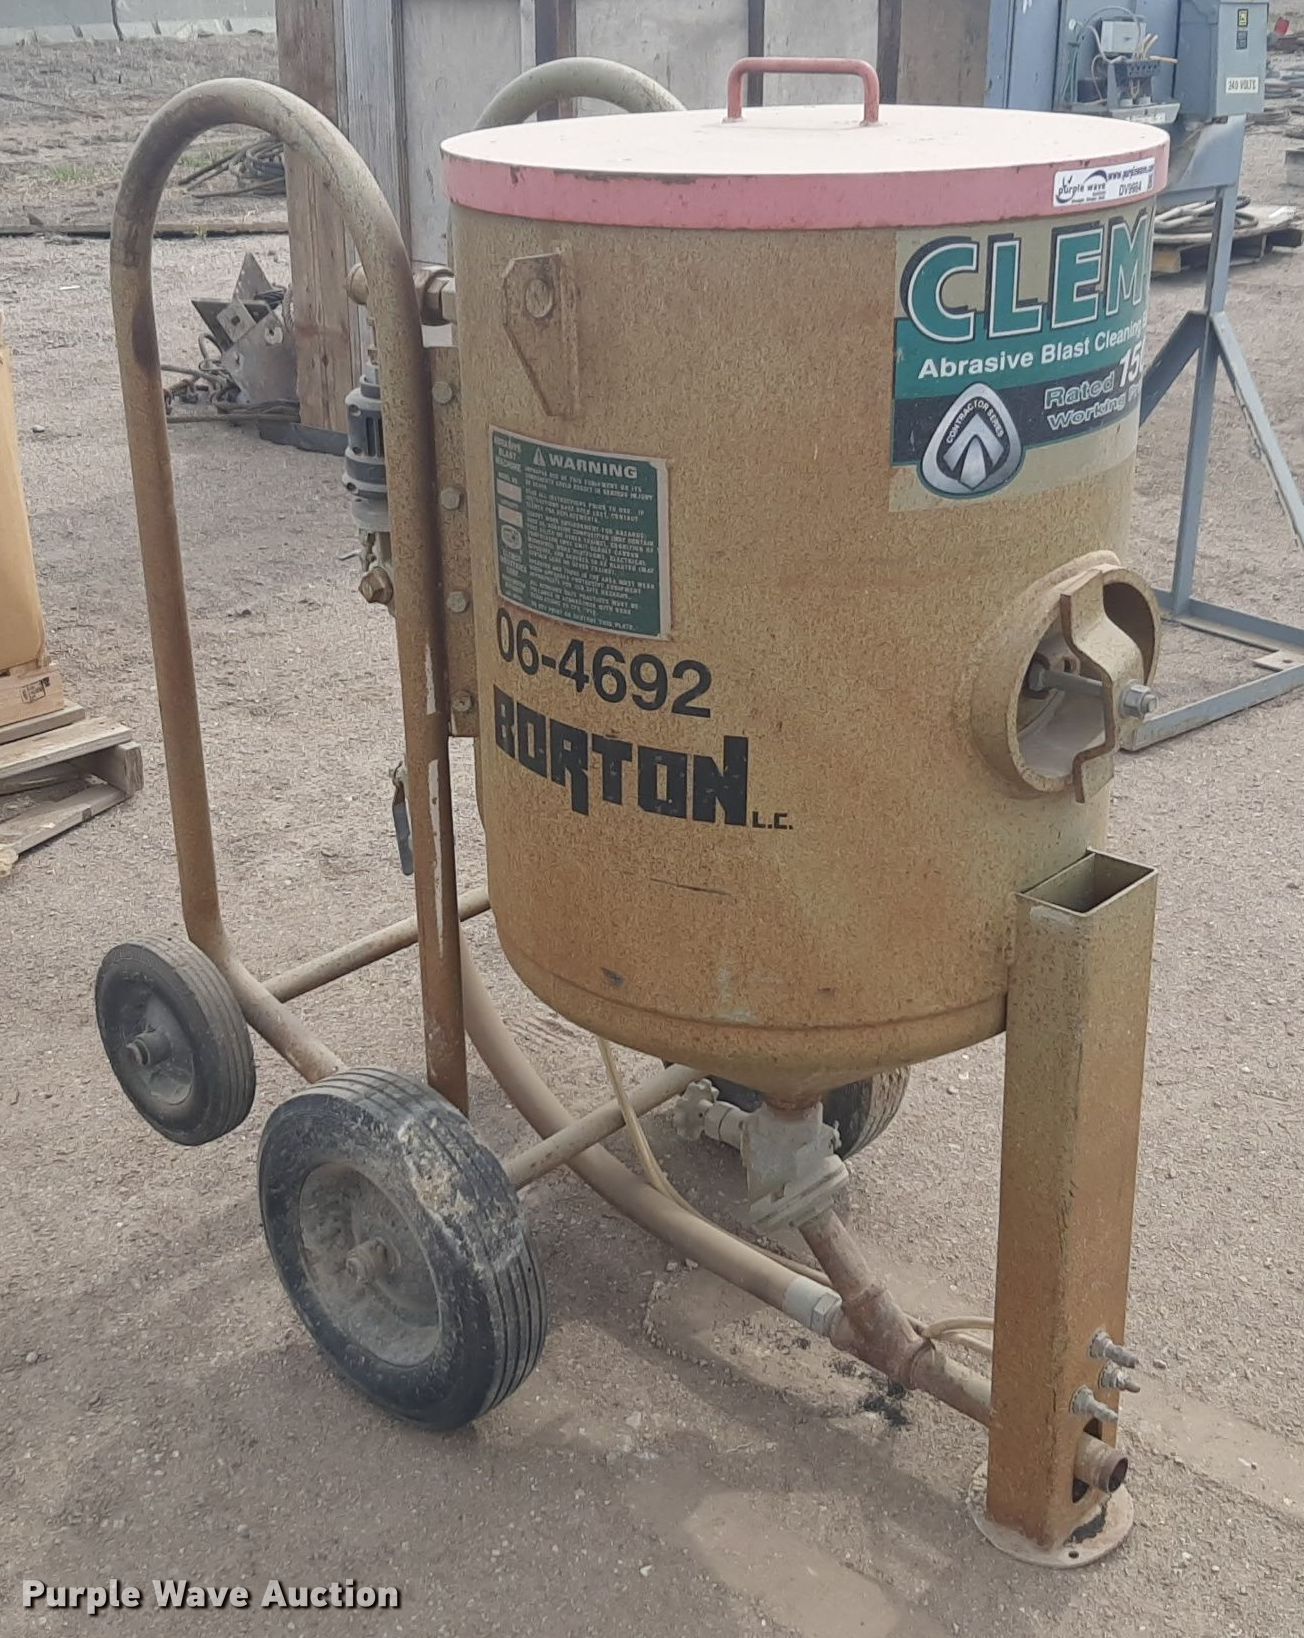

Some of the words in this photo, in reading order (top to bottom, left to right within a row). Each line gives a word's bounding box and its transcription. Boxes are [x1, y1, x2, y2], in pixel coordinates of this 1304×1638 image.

[1058, 179, 1085, 197] purple
[1087, 182, 1106, 192] wave
[918, 351, 1034, 379] Abrasive
[1041, 338, 1090, 364] Blast
[1095, 317, 1142, 352] Cleaning
[1043, 370, 1115, 410] Rated
[946, 399, 989, 444] CONTRACTOR
[986, 407, 1005, 438] SERIES
[1047, 392, 1127, 431] Working
[548, 453, 638, 479] WARNING
[496, 607, 712, 718] 06-4692
[493, 684, 749, 826] BORTON
[752, 811, 794, 830] L.C.
